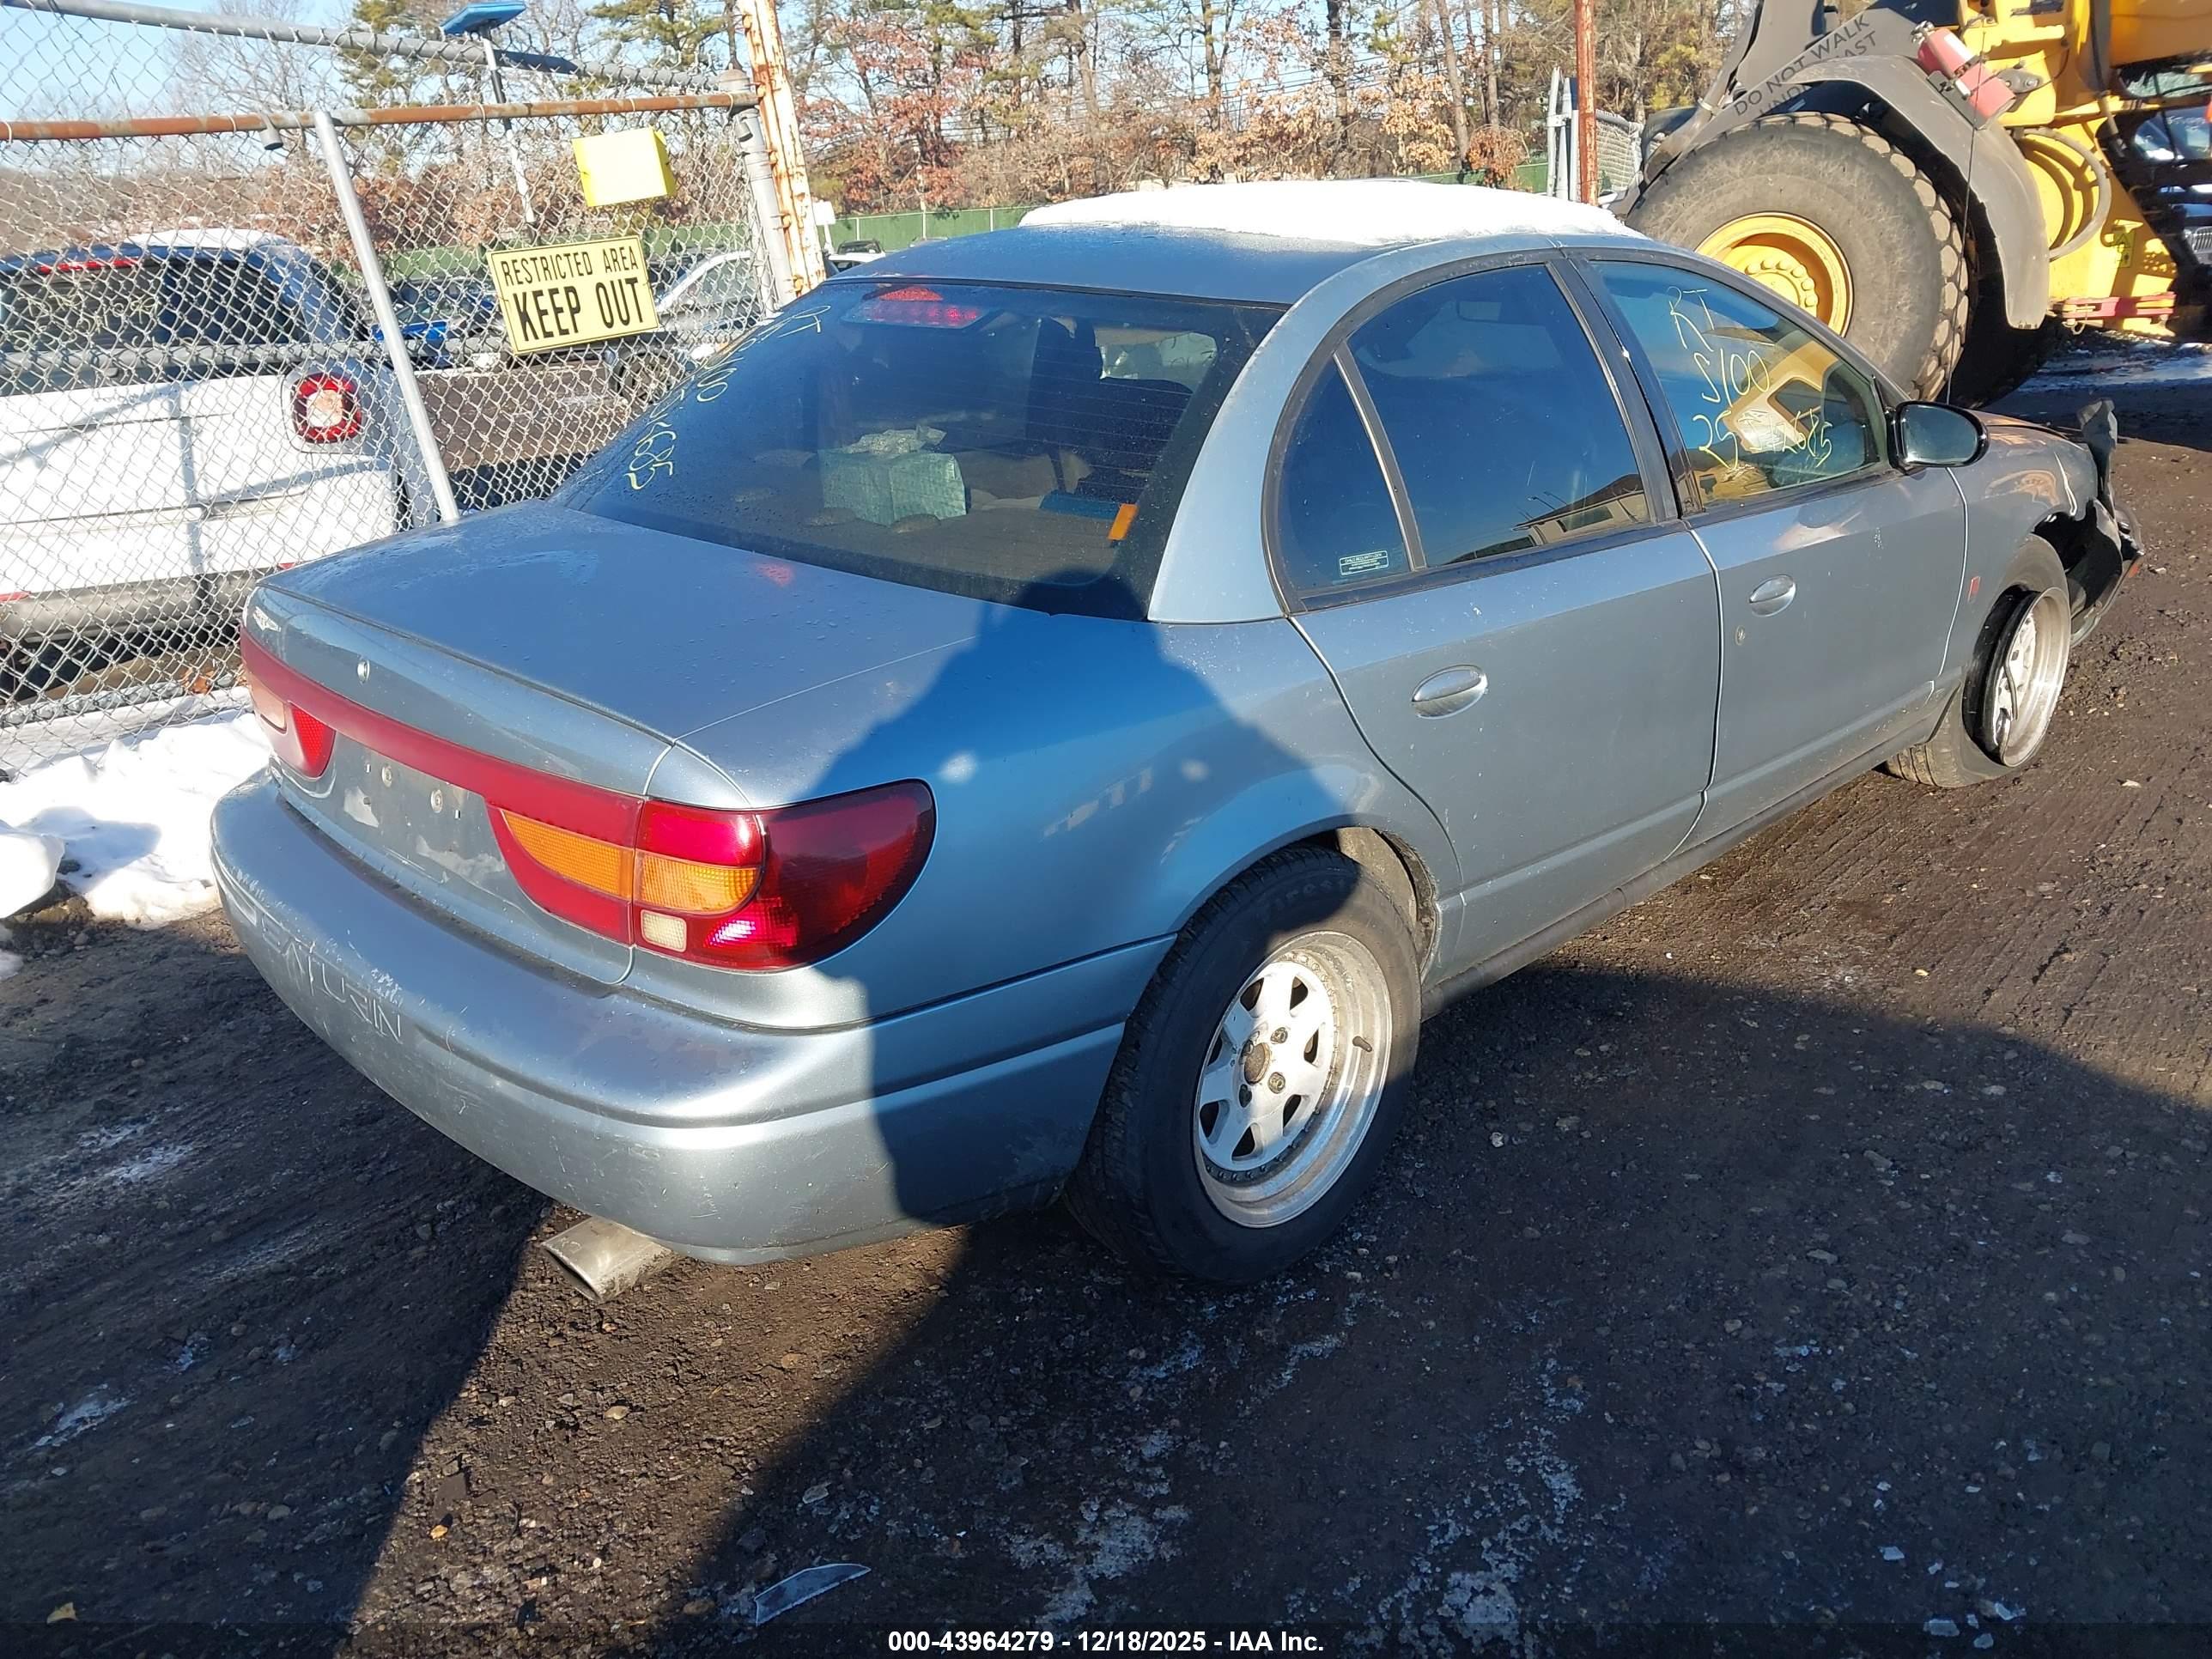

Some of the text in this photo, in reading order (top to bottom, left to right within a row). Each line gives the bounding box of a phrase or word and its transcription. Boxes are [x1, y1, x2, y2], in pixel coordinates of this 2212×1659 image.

[1734, 89, 1761, 116] DO
[1766, 57, 1806, 93] NOT
[1810, 15, 1869, 59] WALK
[501, 246, 639, 286] RESTRICTED AREA
[513, 277, 643, 342] KEEP OUT
[1667, 286, 1714, 352] RT
